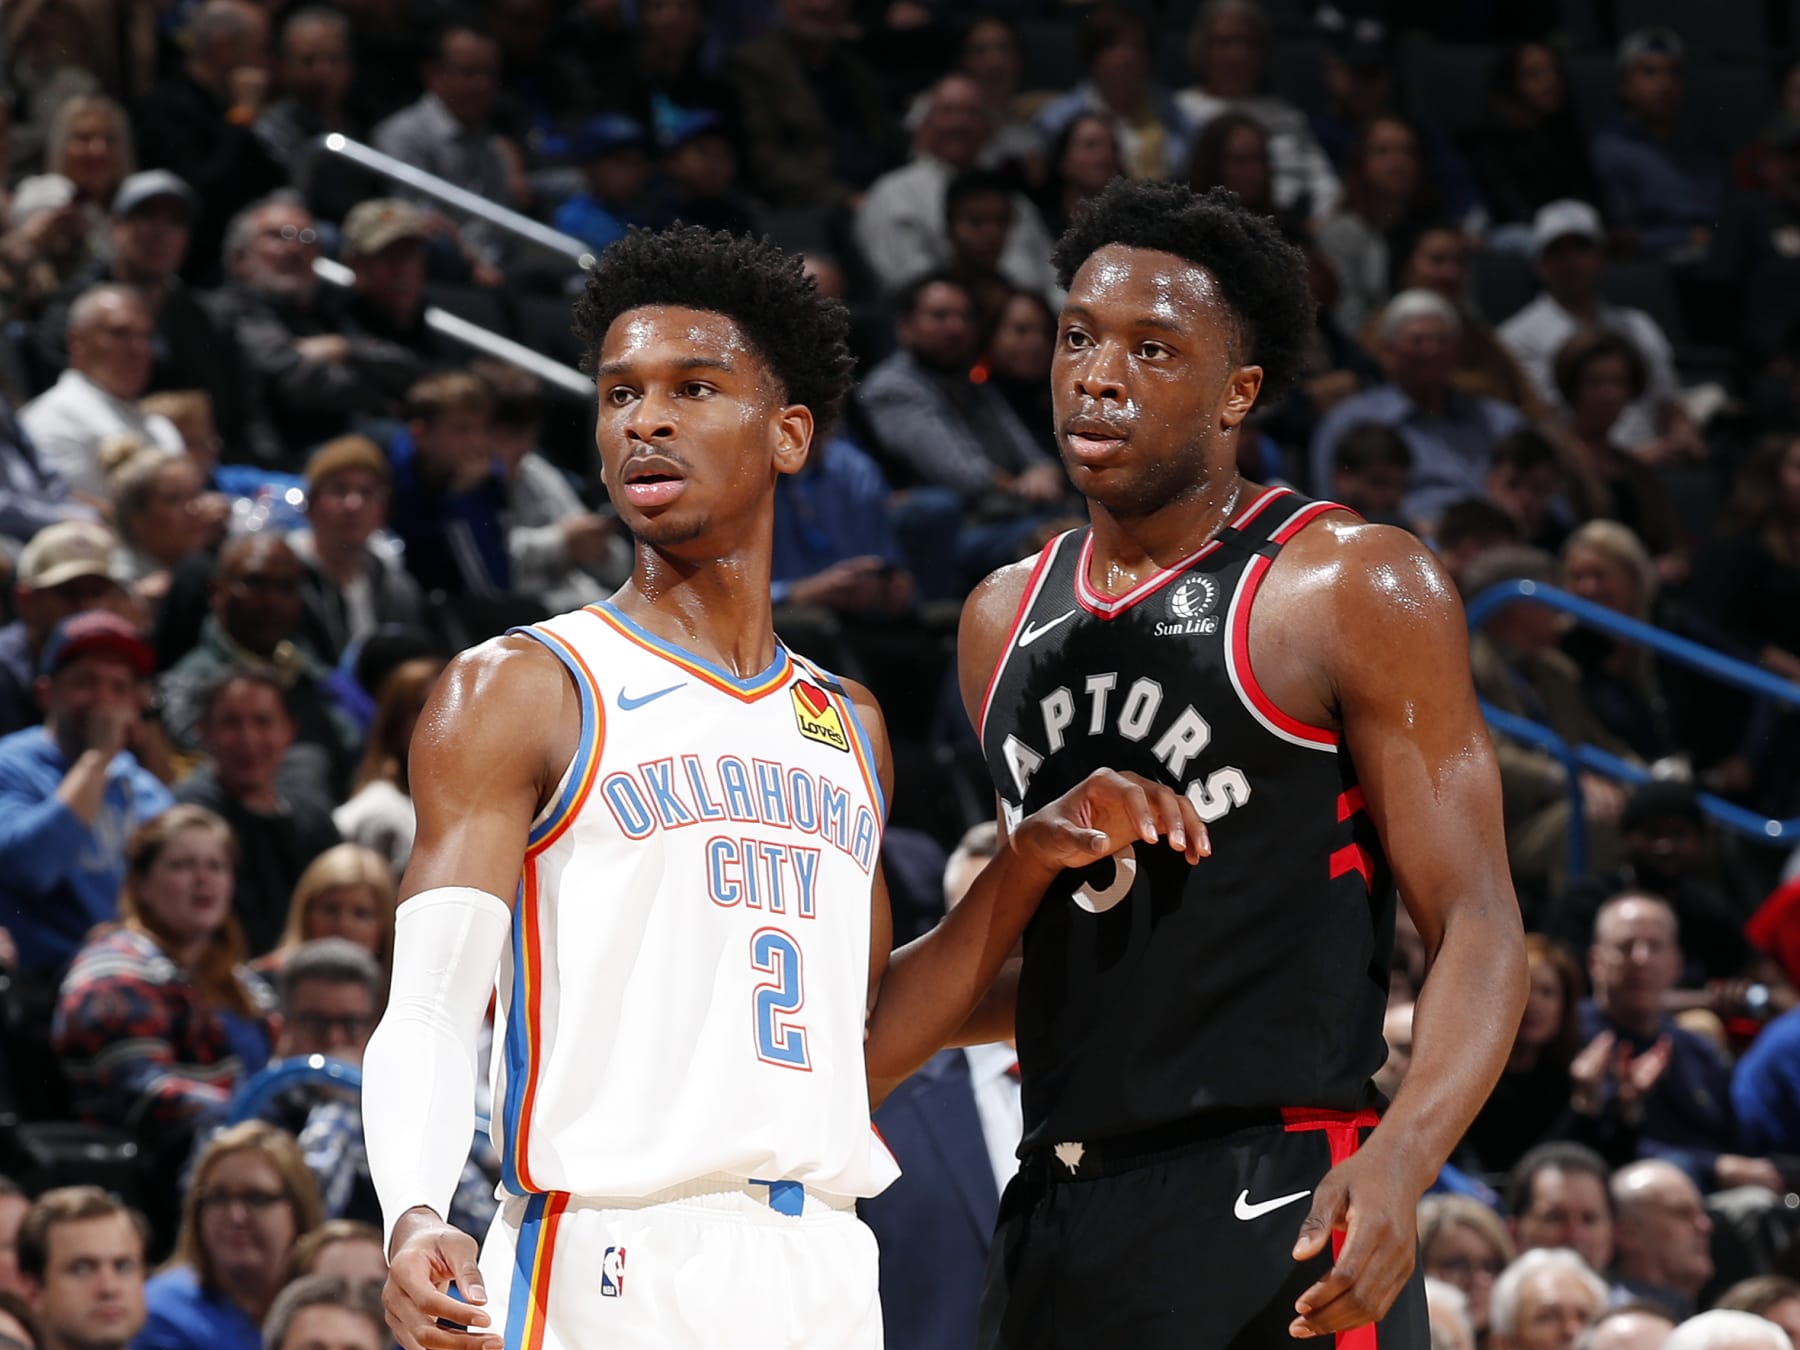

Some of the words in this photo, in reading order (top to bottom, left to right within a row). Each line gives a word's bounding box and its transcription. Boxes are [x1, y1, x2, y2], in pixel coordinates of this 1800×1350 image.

[1154, 621, 1183, 636] Sun
[1185, 618, 1215, 633] Life
[601, 755, 878, 874] OKLAHOMA
[705, 836, 820, 919] CITY
[750, 926, 813, 1072] 2
